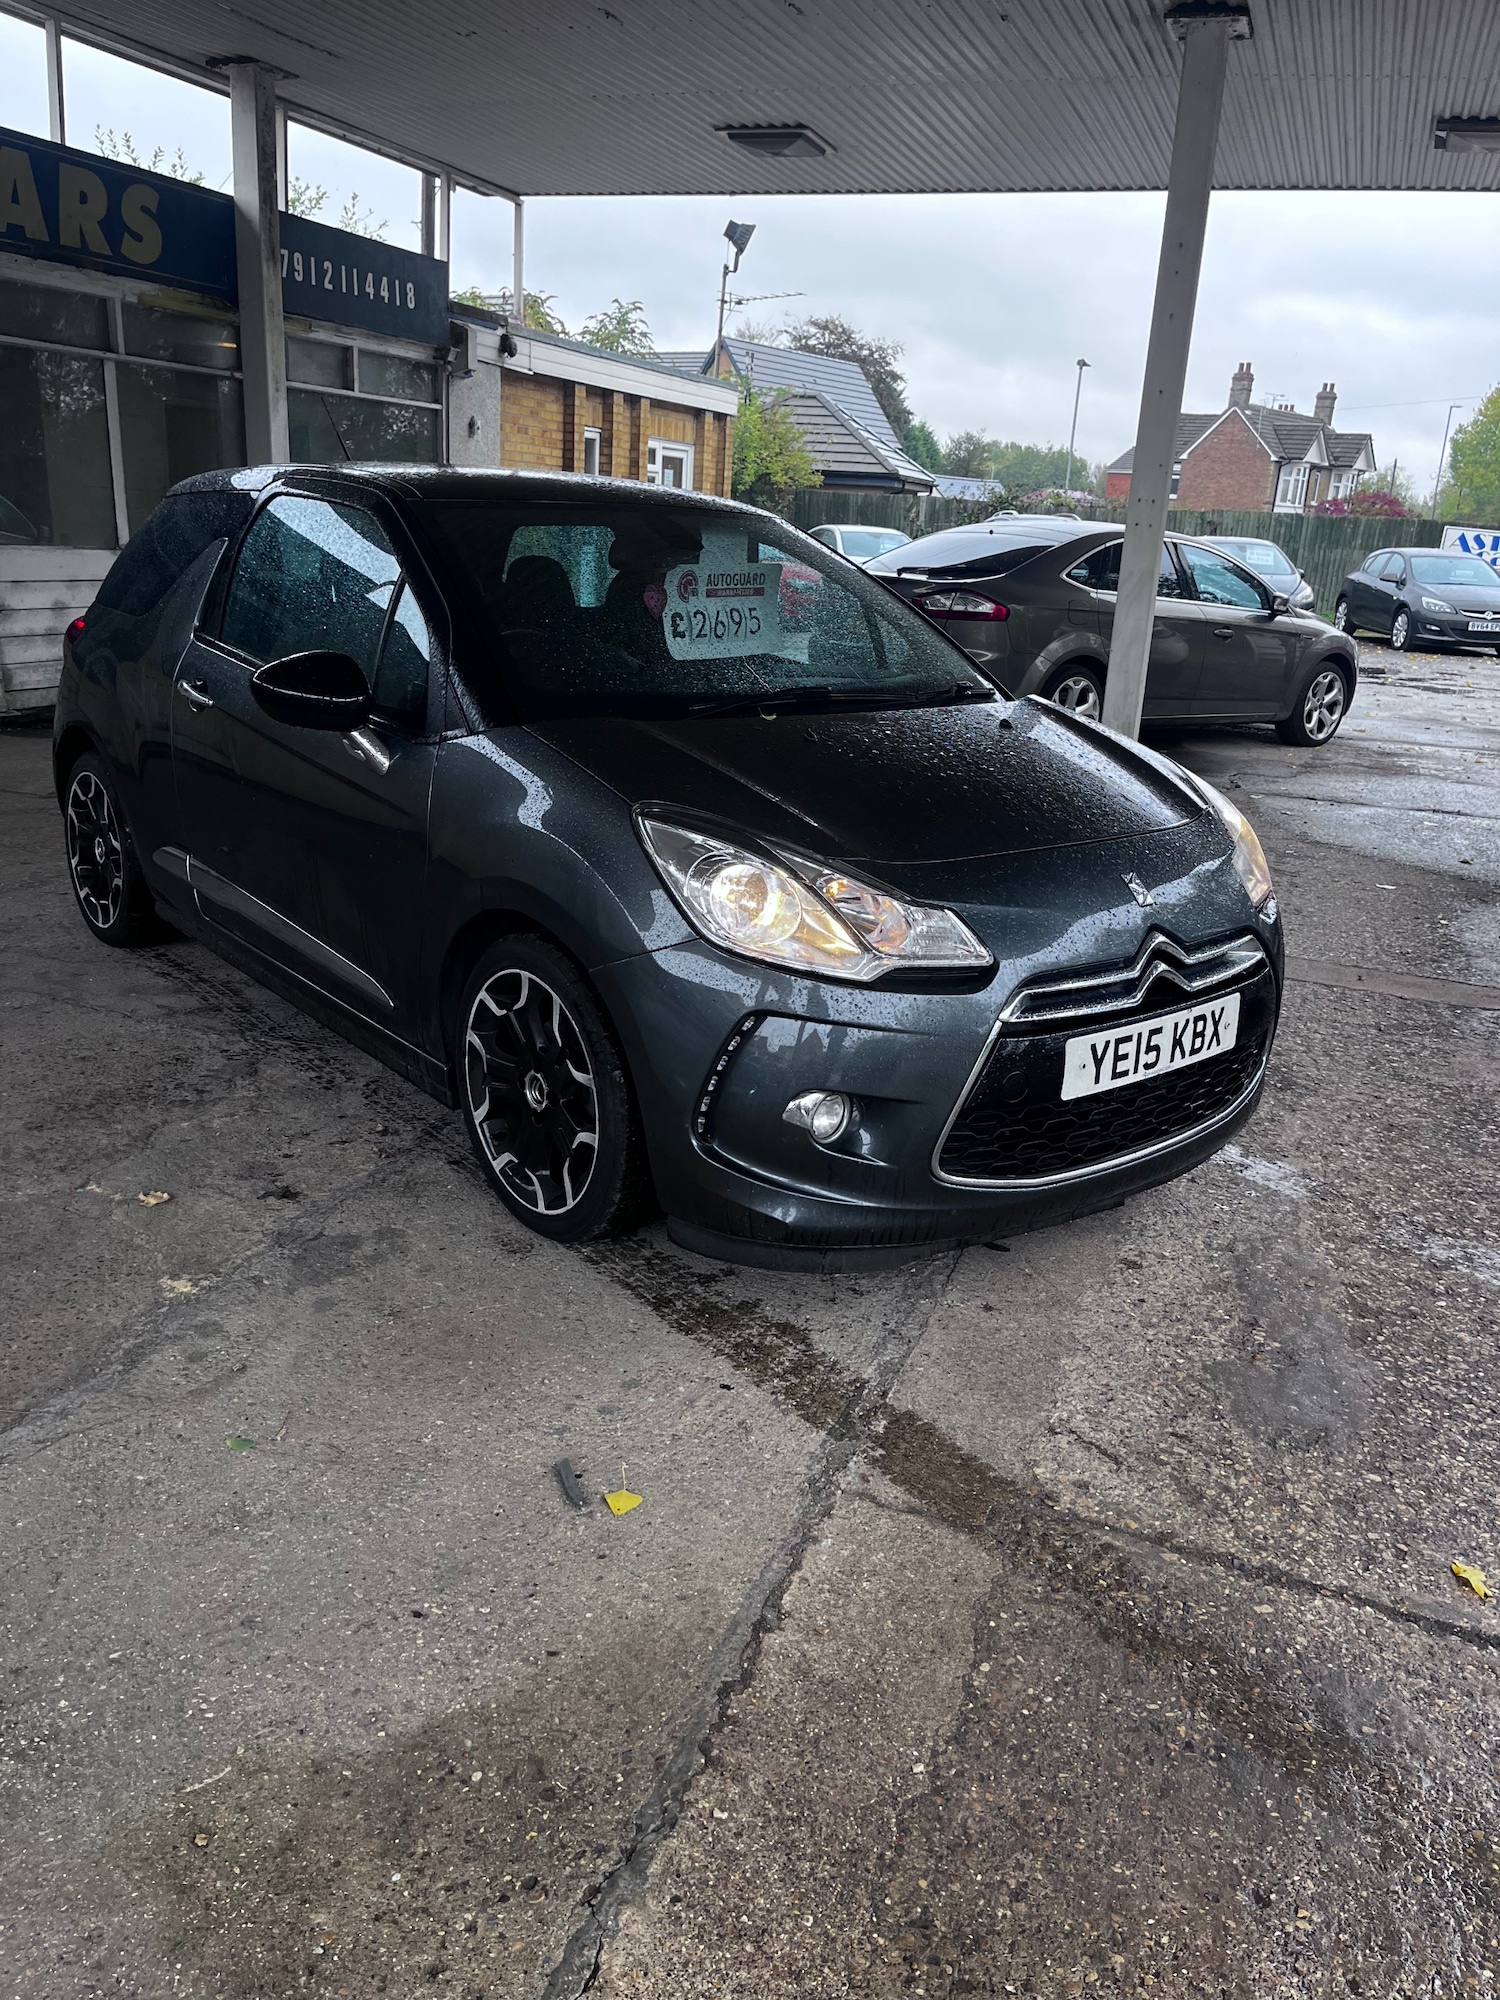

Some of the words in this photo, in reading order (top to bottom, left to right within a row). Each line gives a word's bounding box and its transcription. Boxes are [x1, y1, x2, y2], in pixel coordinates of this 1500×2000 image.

[0, 145, 163, 265] ARS
[280, 248, 416, 310] 7912114418
[705, 572, 766, 588] AUTOGUARD
[670, 606, 762, 640] £2695
[1470, 622, 1489, 630] BV64
[1090, 1025, 1164, 1085] YE15
[1169, 1006, 1225, 1064] KBX
